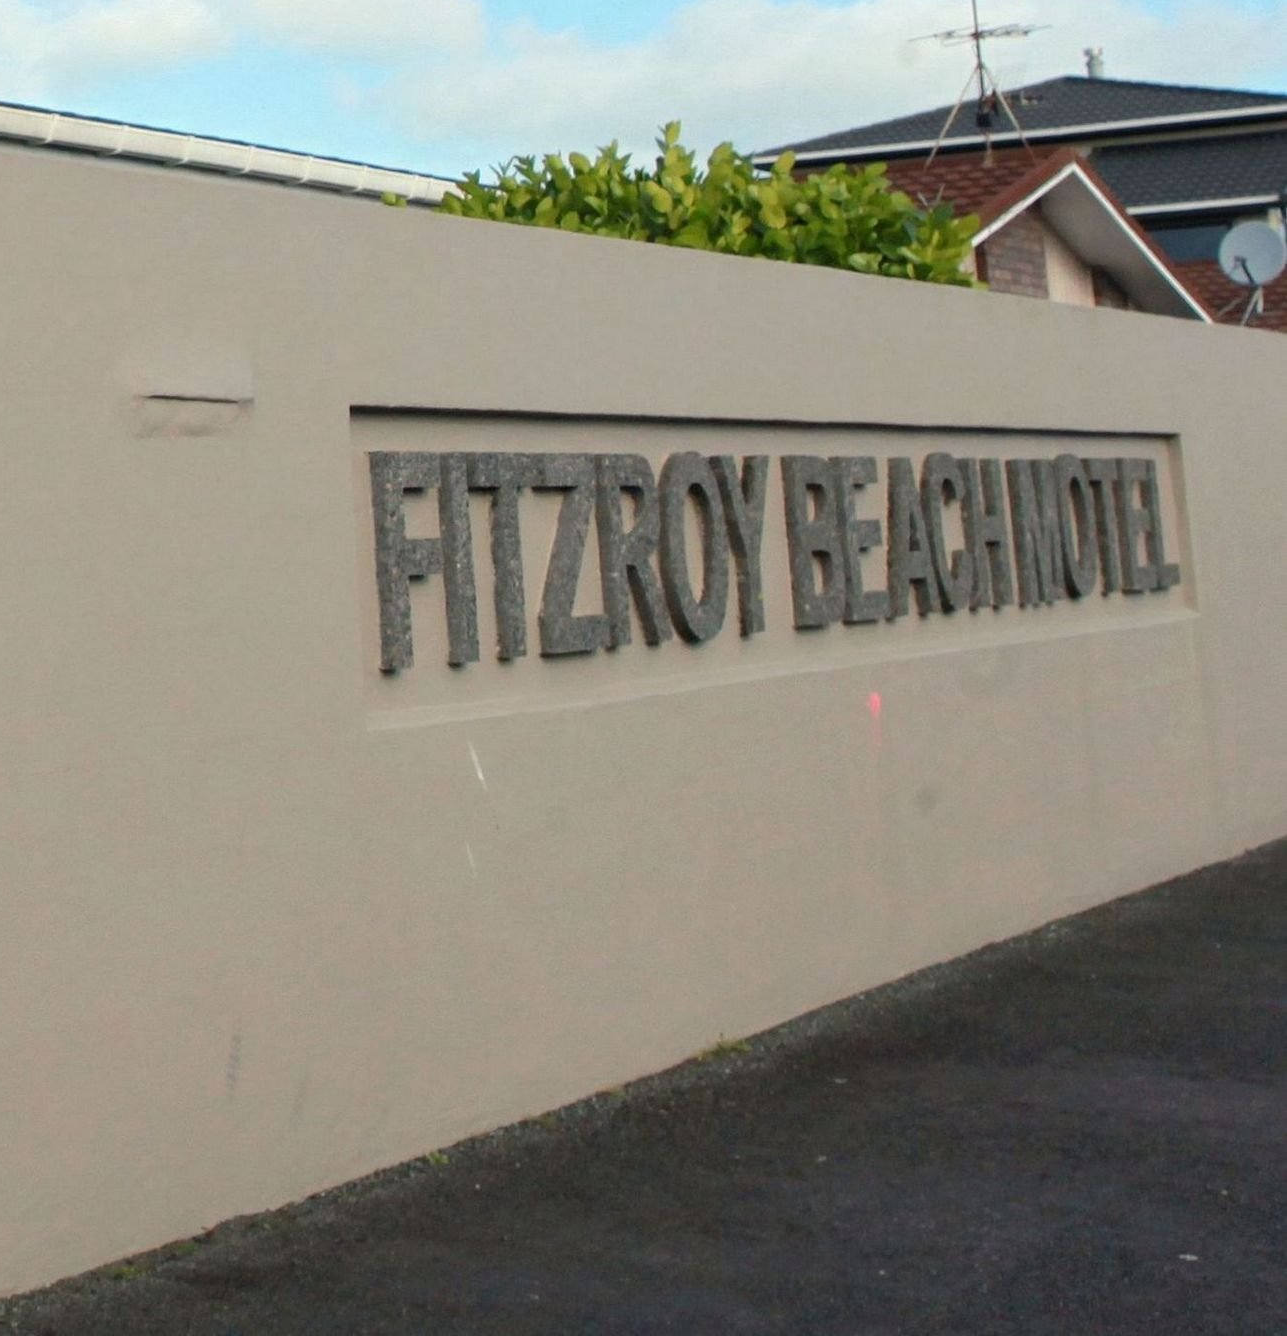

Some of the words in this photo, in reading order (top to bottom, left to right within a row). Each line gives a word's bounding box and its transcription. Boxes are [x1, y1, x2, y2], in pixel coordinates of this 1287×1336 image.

[368, 450, 769, 672] FITZROY
[780, 452, 1013, 631] BEACH
[1005, 453, 1181, 610] MOTEL
